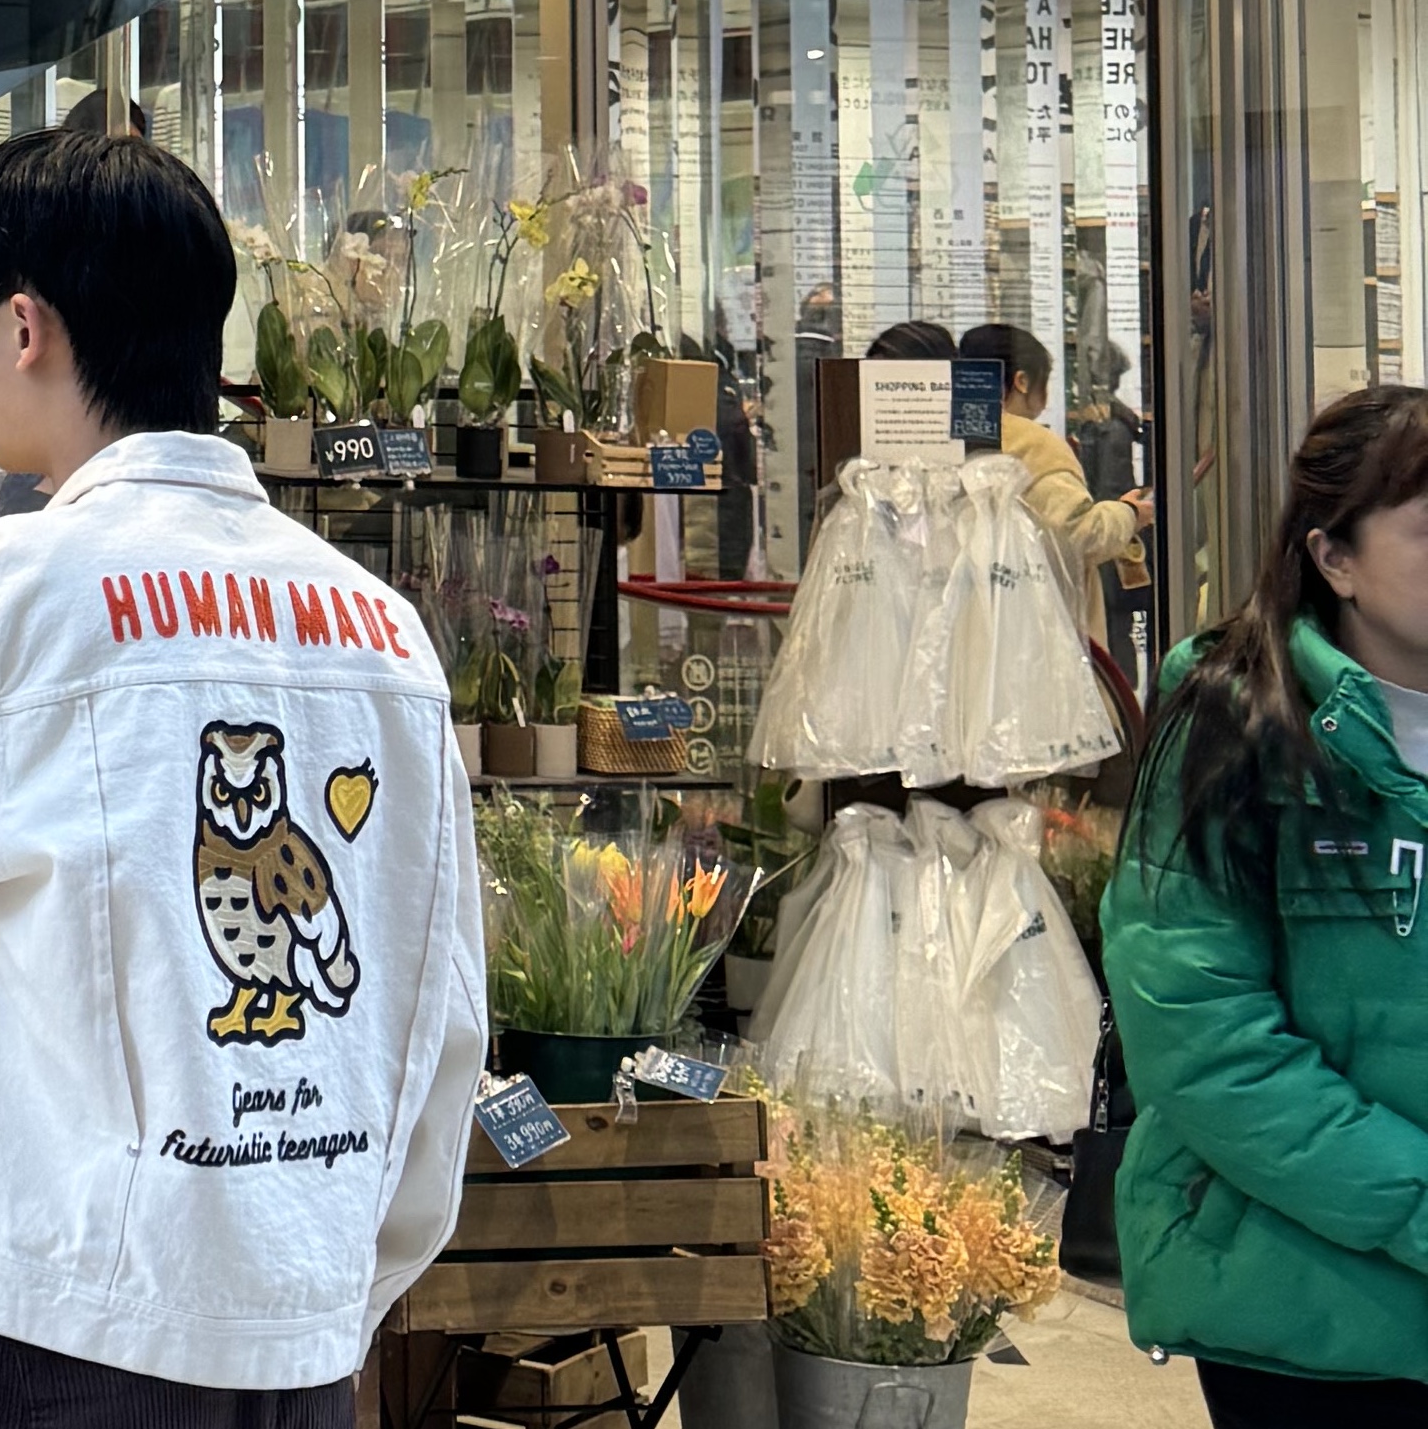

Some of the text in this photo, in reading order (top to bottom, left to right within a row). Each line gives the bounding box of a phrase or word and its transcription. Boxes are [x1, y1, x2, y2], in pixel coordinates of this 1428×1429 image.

[326, 436, 374, 465] ¥990
[102, 570, 411, 659] HUMAN MADE
[233, 1077, 323, 1128] Gears for
[277, 1130, 368, 1169] teenagers
